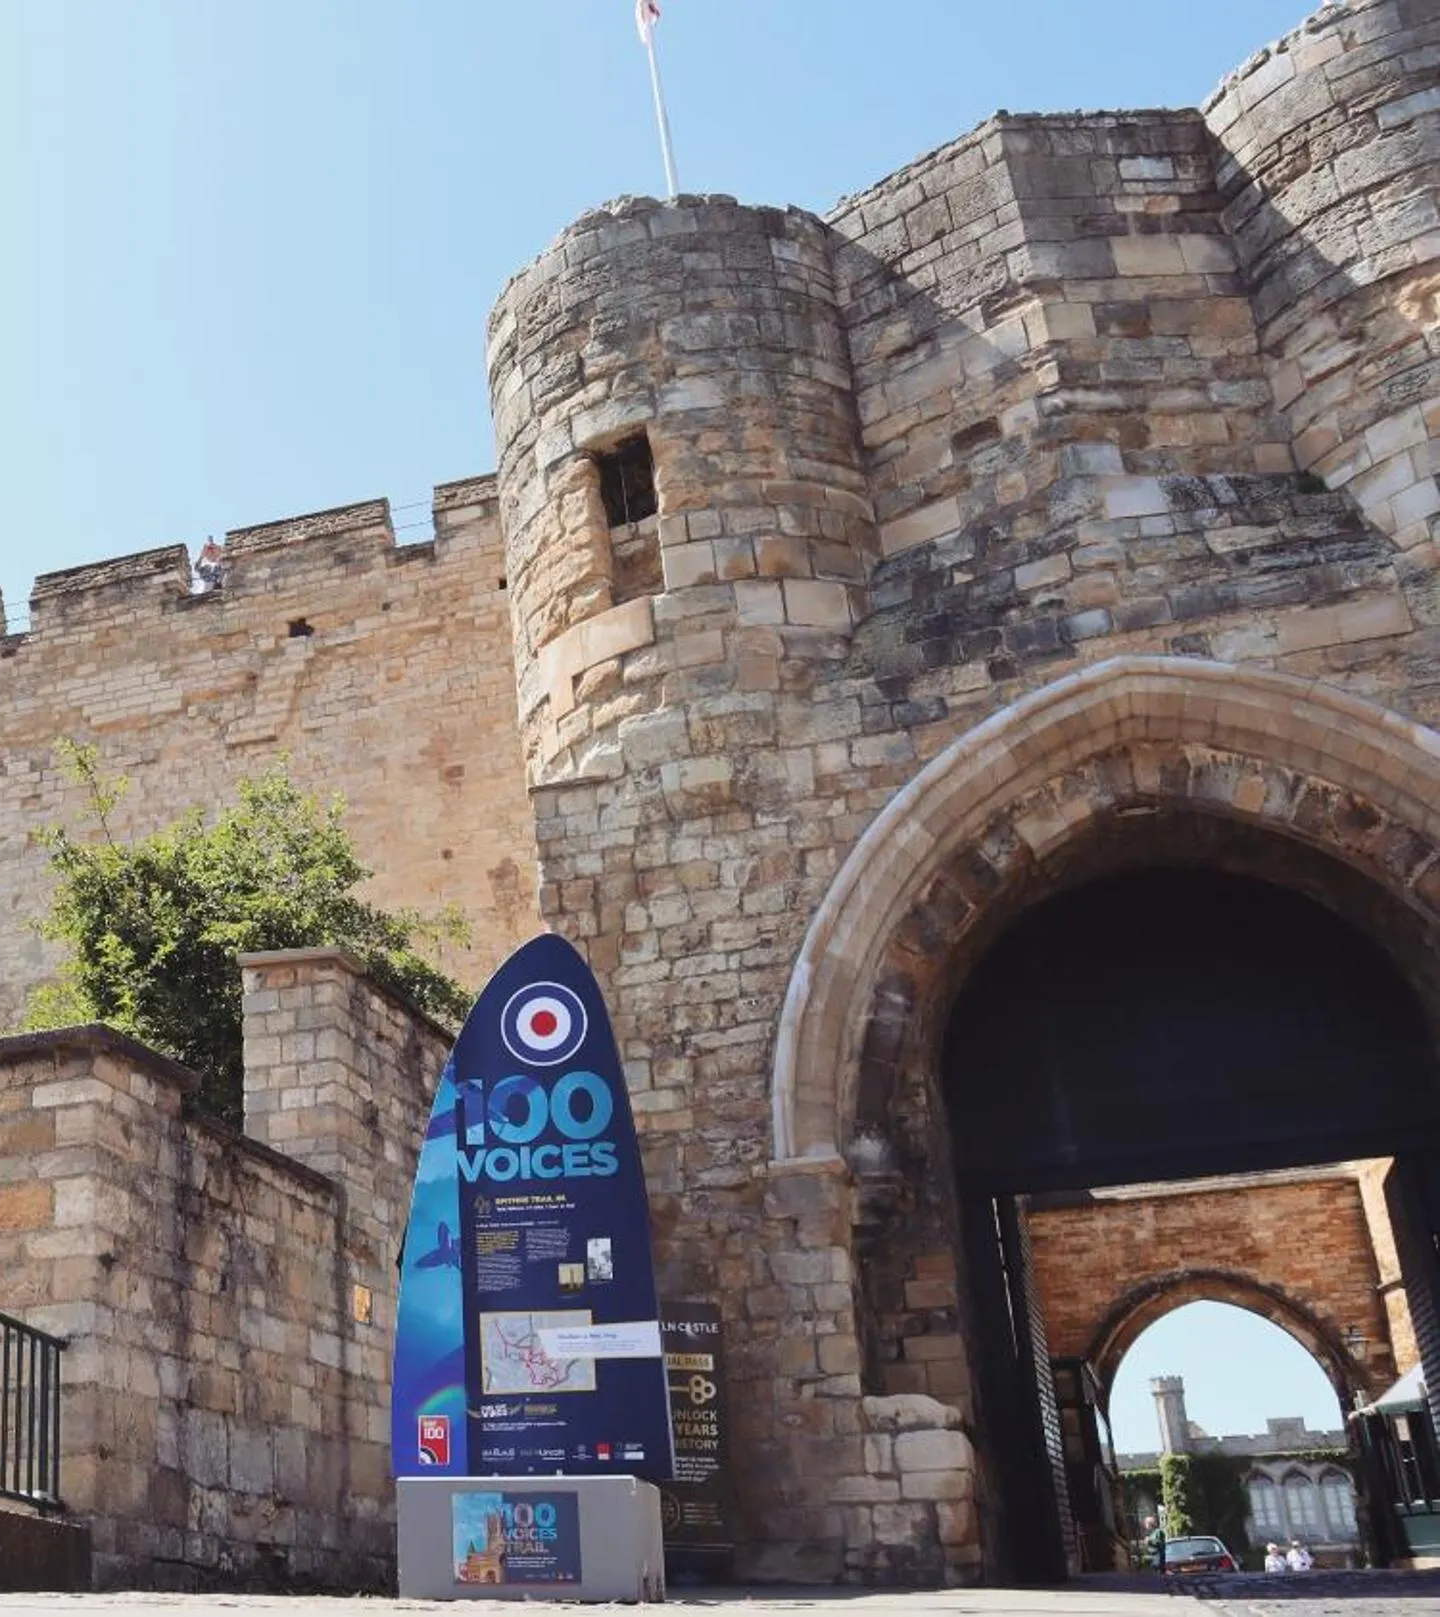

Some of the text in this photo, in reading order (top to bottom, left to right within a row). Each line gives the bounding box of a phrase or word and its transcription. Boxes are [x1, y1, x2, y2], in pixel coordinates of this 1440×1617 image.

[455, 1071, 613, 1145] 100
[457, 1143, 619, 1183] VOICES
[675, 1423, 718, 1436] YEARS
[500, 1503, 557, 1529] 100
